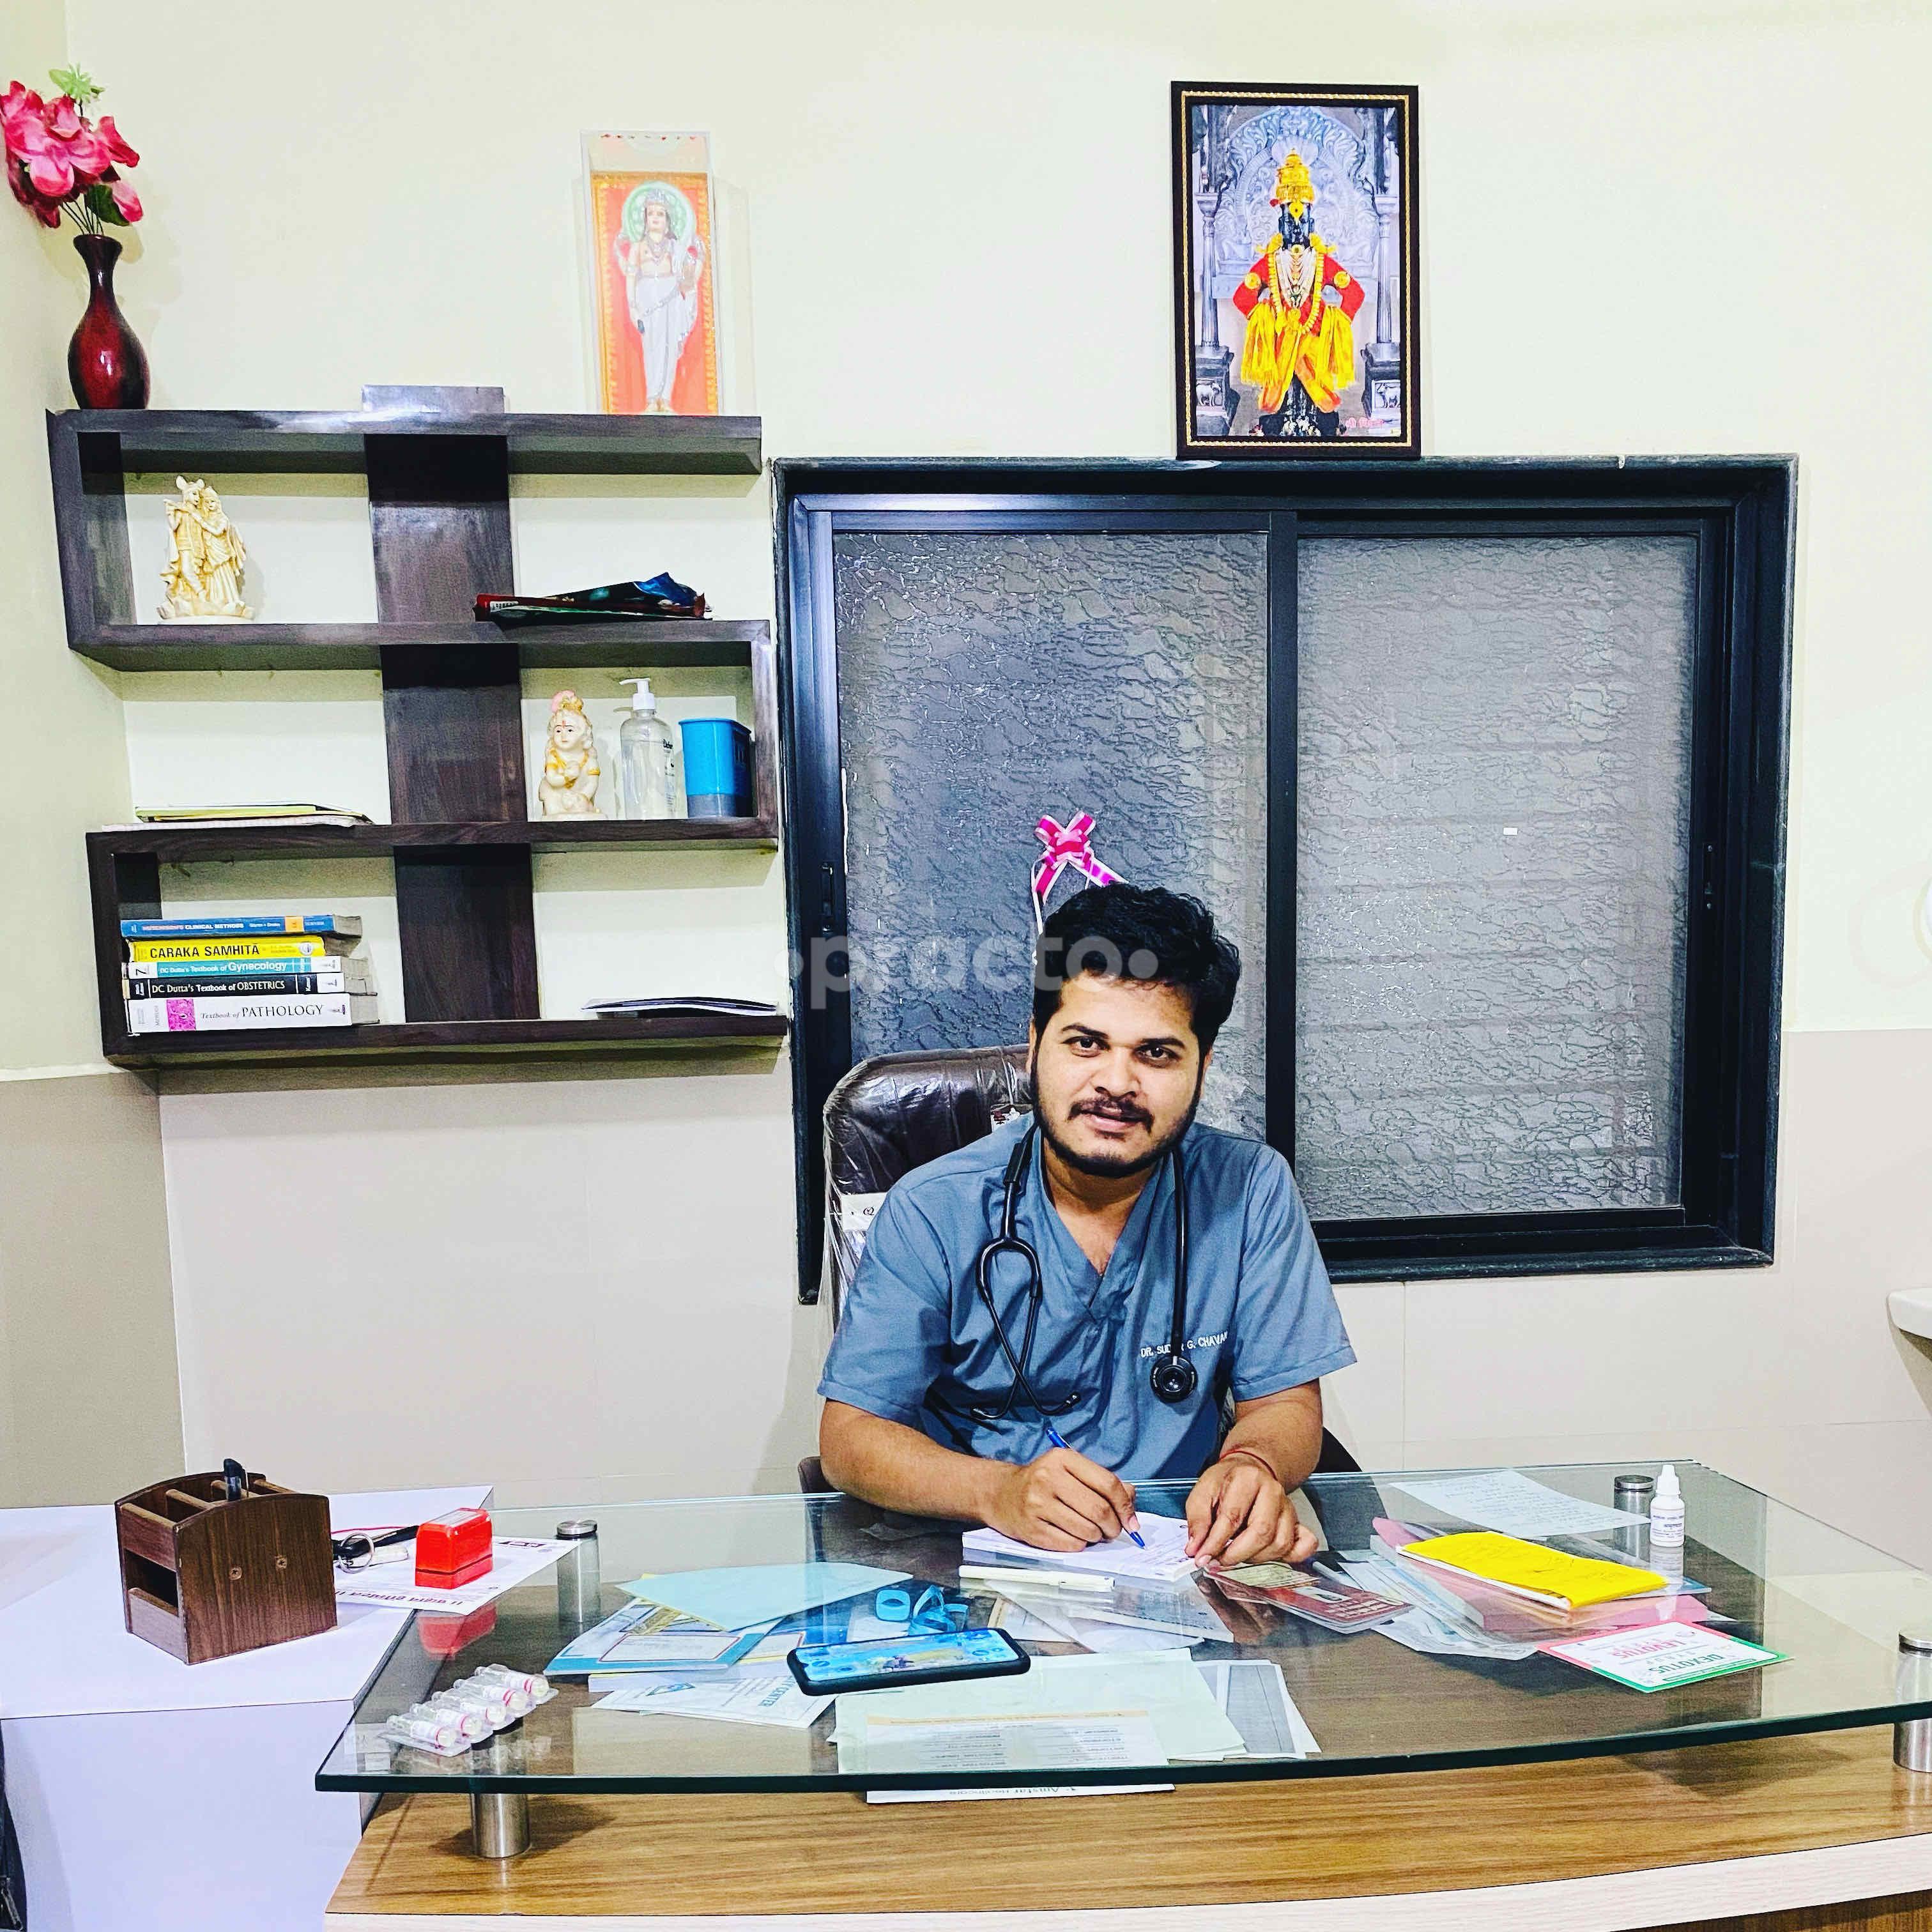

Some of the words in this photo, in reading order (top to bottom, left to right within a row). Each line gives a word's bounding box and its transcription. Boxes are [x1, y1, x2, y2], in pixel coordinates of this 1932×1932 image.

[150, 947, 199, 958] CARAKA
[228, 961, 287, 972] Gynecology
[152, 985, 165, 993] DC
[167, 984, 194, 993] Dutta's
[228, 983, 236, 991] of
[237, 980, 286, 990] OBSTETRICS
[241, 1004, 324, 1017] PATHOLOGY
[1612, 1639, 1687, 1659] LEVOTUS
[1648, 1653, 1726, 1674] DEXOTUS
